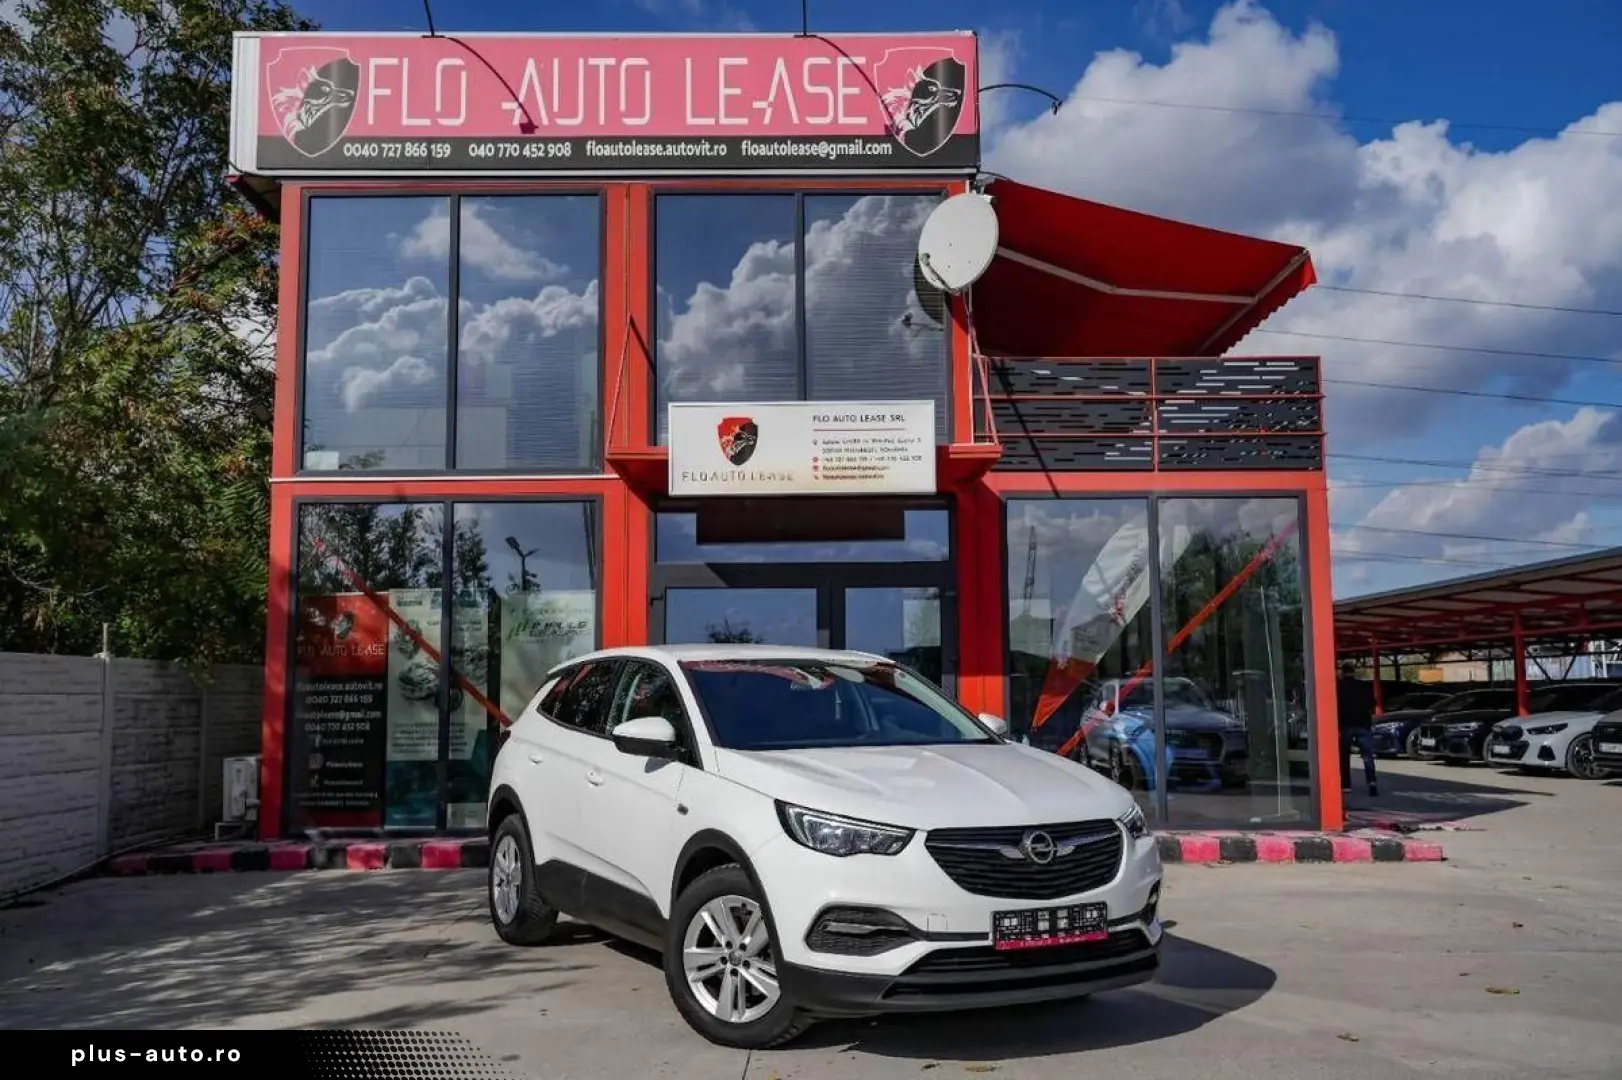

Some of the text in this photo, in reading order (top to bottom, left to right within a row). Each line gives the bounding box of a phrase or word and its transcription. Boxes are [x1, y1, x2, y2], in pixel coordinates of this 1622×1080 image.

[367, 57, 868, 126] FLO AUTO LEASE
[343, 142, 451, 159] 0040 727 866 159
[468, 142, 572, 158] 040 770 452 908
[586, 140, 728, 157] floautolease.autovit.ro
[741, 140, 892, 160] floautolease@gmail.com
[813, 414, 906, 423] FLO AUTO LEASE SRL
[682, 471, 708, 482] FLO
[710, 470, 746, 482] AUTO
